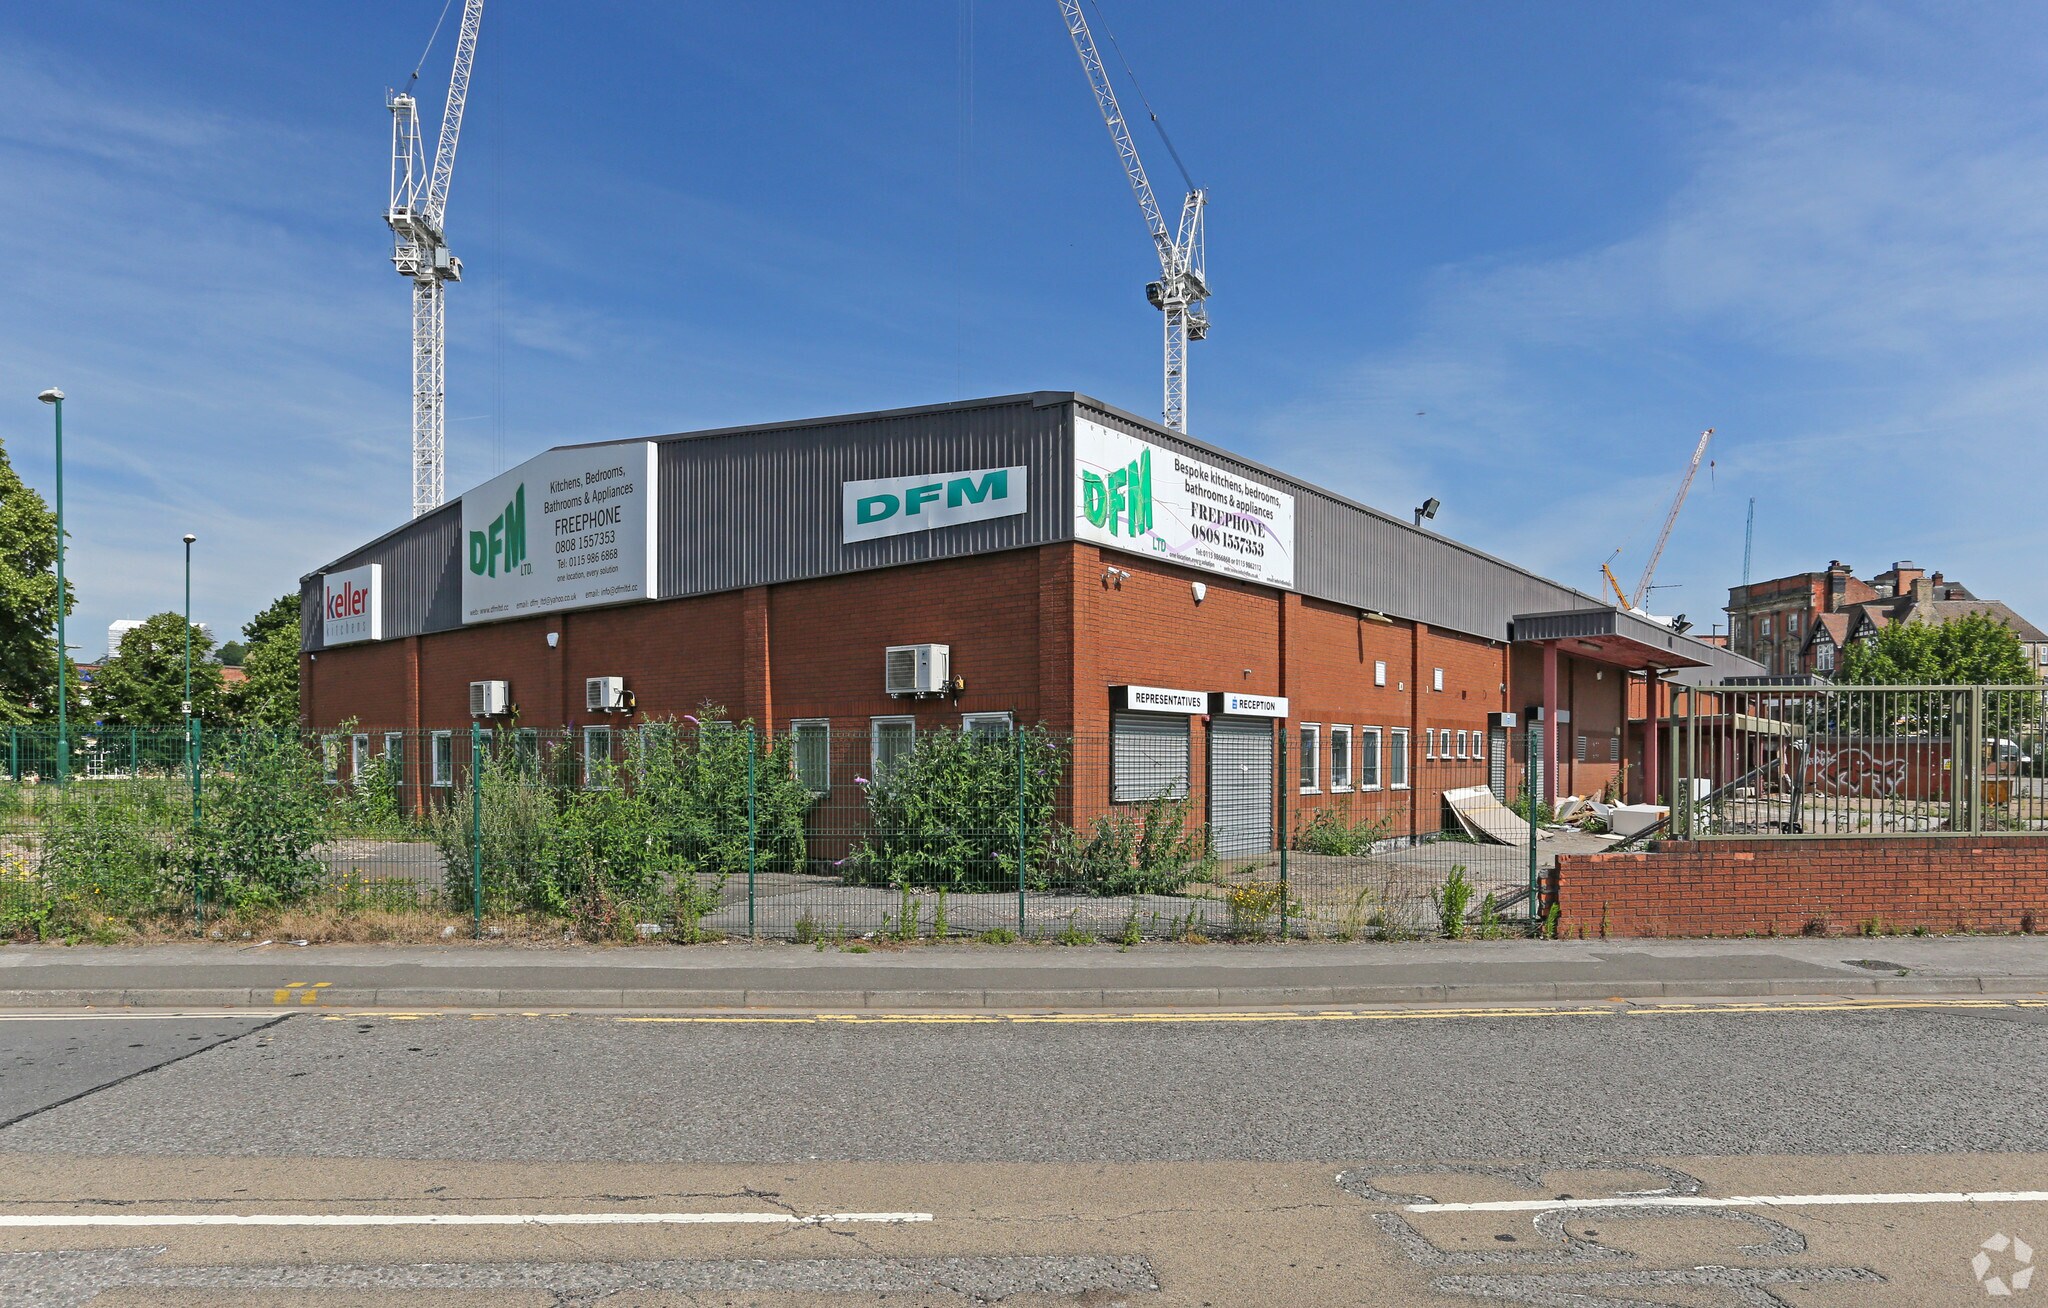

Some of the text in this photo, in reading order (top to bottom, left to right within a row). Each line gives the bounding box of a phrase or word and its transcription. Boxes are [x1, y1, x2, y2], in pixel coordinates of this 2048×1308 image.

[550, 466, 626, 494] Kitchens, Bedrooms,
[856, 459, 1008, 515] DFM
[1083, 448, 1153, 538] DFM
[1174, 458, 1281, 508] Bespoke kitchens, bedrooms,
[544, 482, 634, 514] Bathrooms & Appliances
[1184, 479, 1274, 520] bathrooms & appliances
[469, 481, 527, 578] DFM
[555, 505, 622, 536] FREEPHONE
[1191, 501, 1266, 538] FREEPHONE
[555, 530, 615, 554] 0808 1557353
[1152, 536, 1167, 552] LTD
[1191, 523, 1264, 557] 0808 1557353
[520, 563, 533, 576] LTD.
[557, 548, 618, 569] Tel: 0115 986 6868
[566, 571, 586, 581] location,
[586, 569, 600, 578] every
[600, 565, 619, 575] solution
[326, 581, 368, 620] keller
[585, 589, 600, 598] email:
[326, 621, 366, 637] kitchens
[1135, 692, 1201, 707] REPRESENTATIVES
[1239, 699, 1276, 711] RECEPTION
